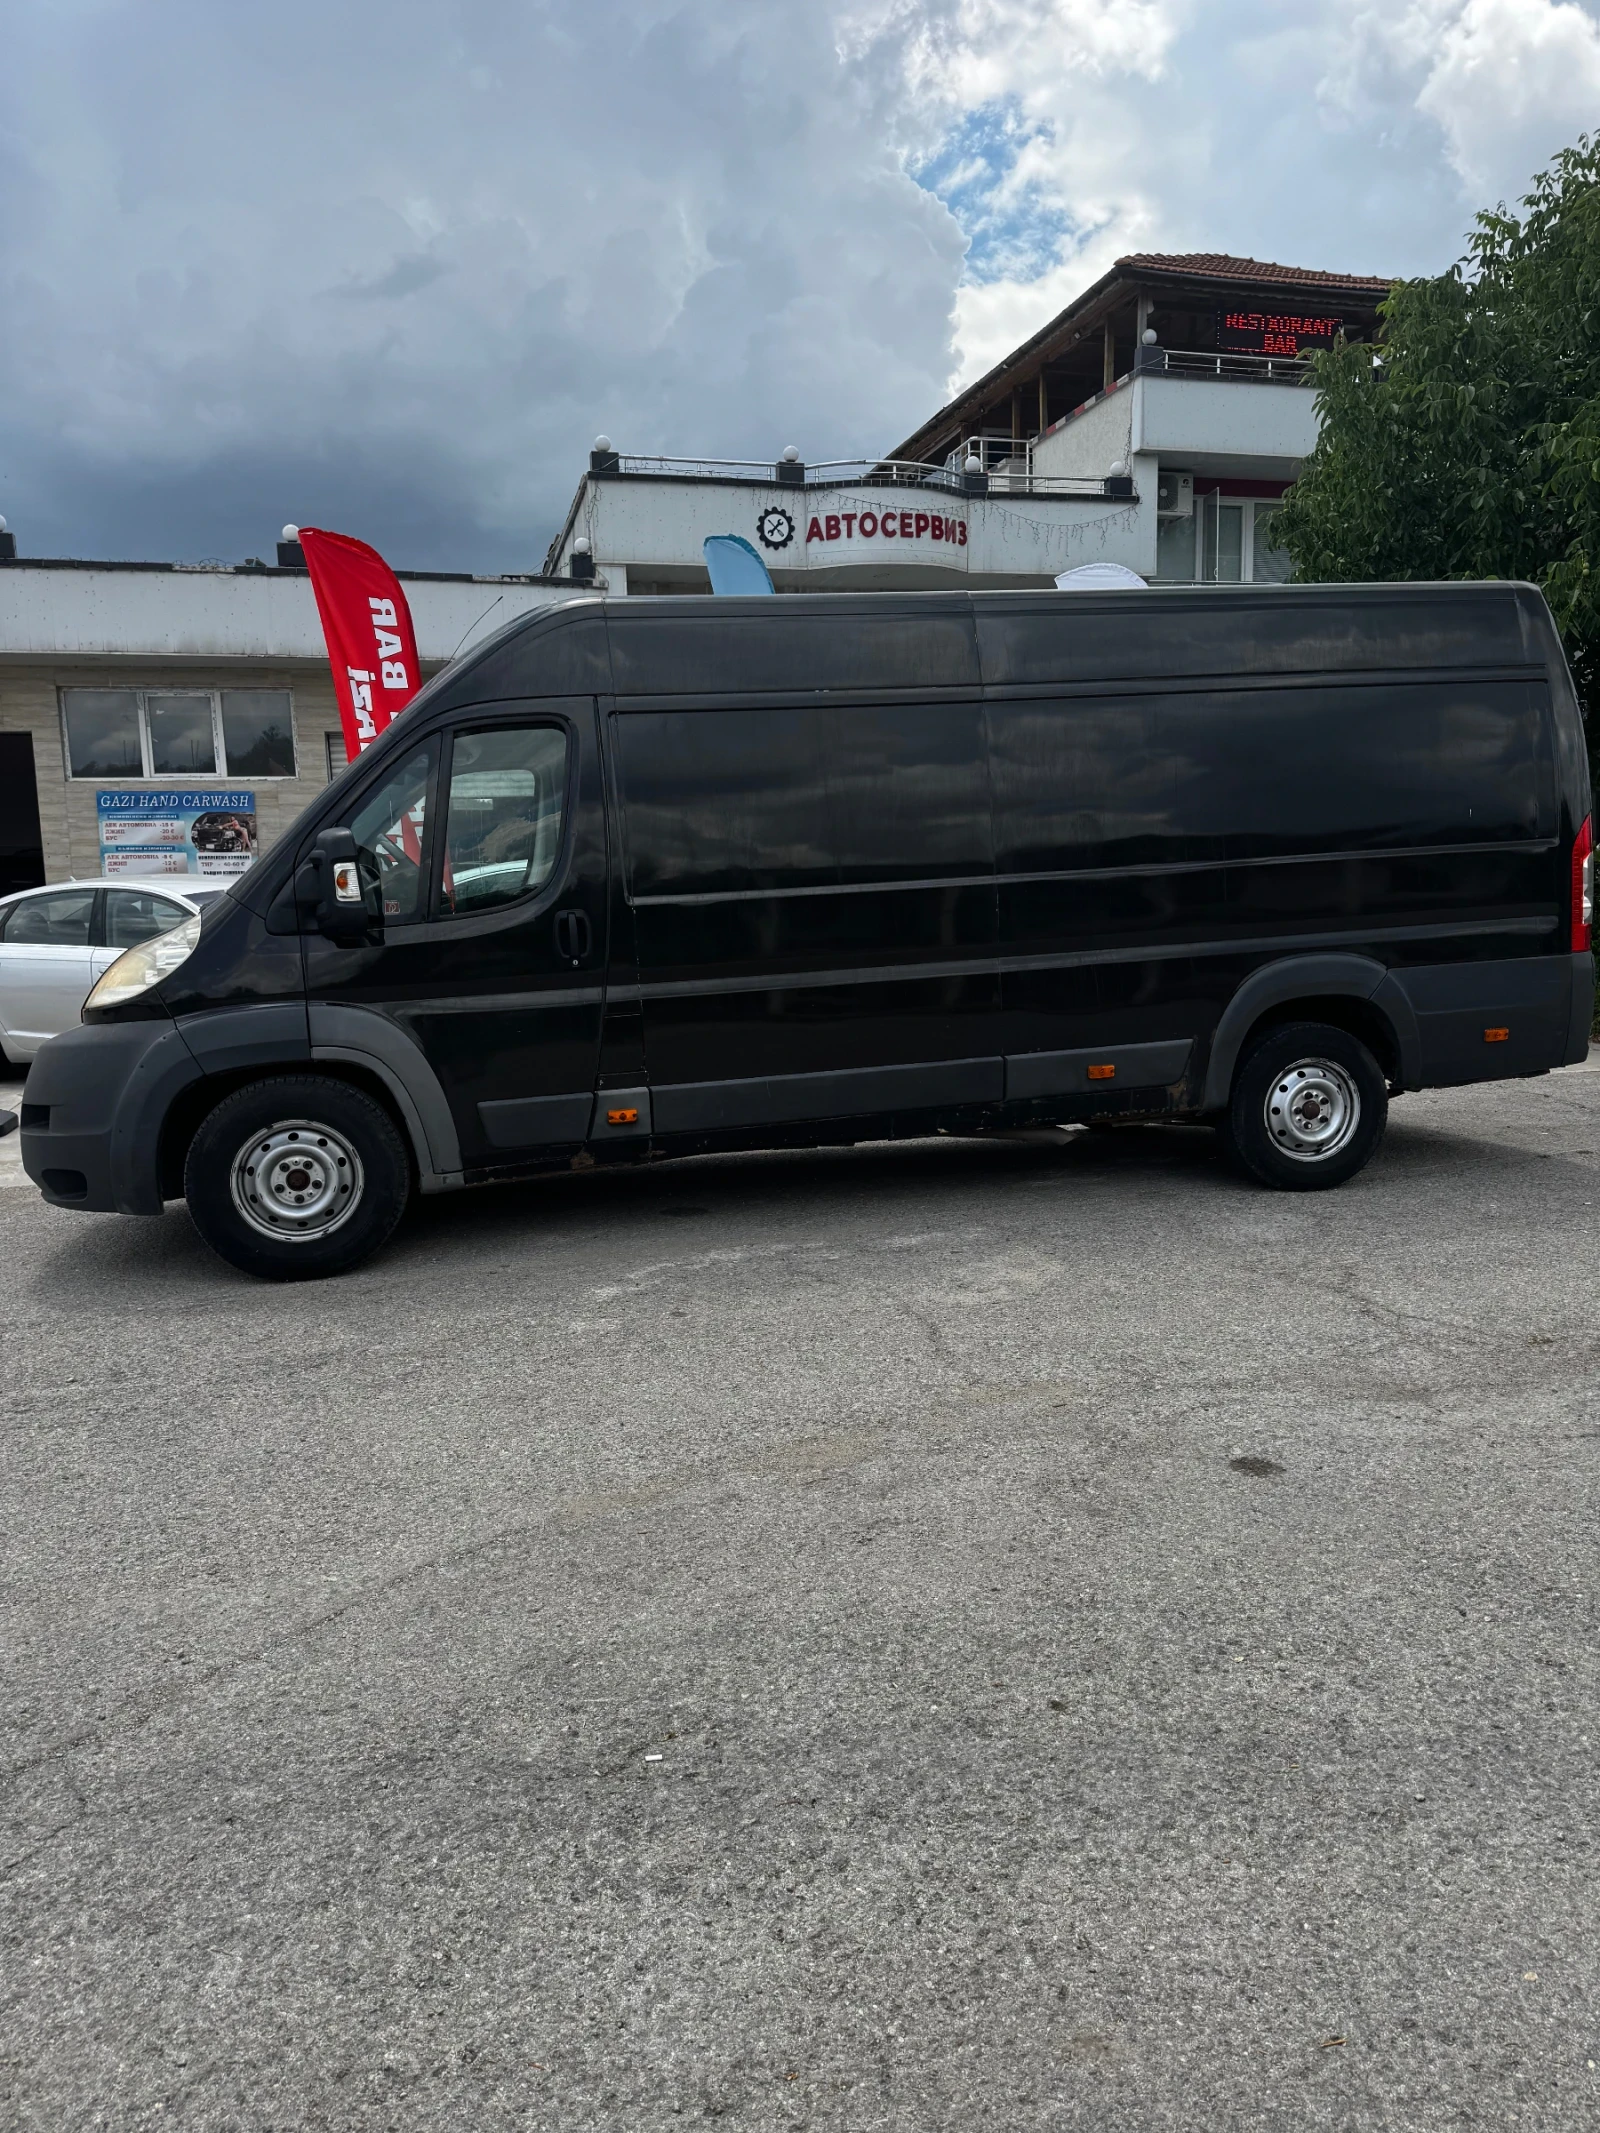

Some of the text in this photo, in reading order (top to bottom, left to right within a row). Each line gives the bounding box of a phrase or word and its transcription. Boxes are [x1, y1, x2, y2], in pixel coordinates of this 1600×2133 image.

[1226, 313, 1335, 335] RESTAURANT
[1264, 334, 1297, 351] BAR
[806, 512, 968, 546] АВТОСЕРВИЗ
[101, 795, 249, 807] GAZI HAND CARWASH
